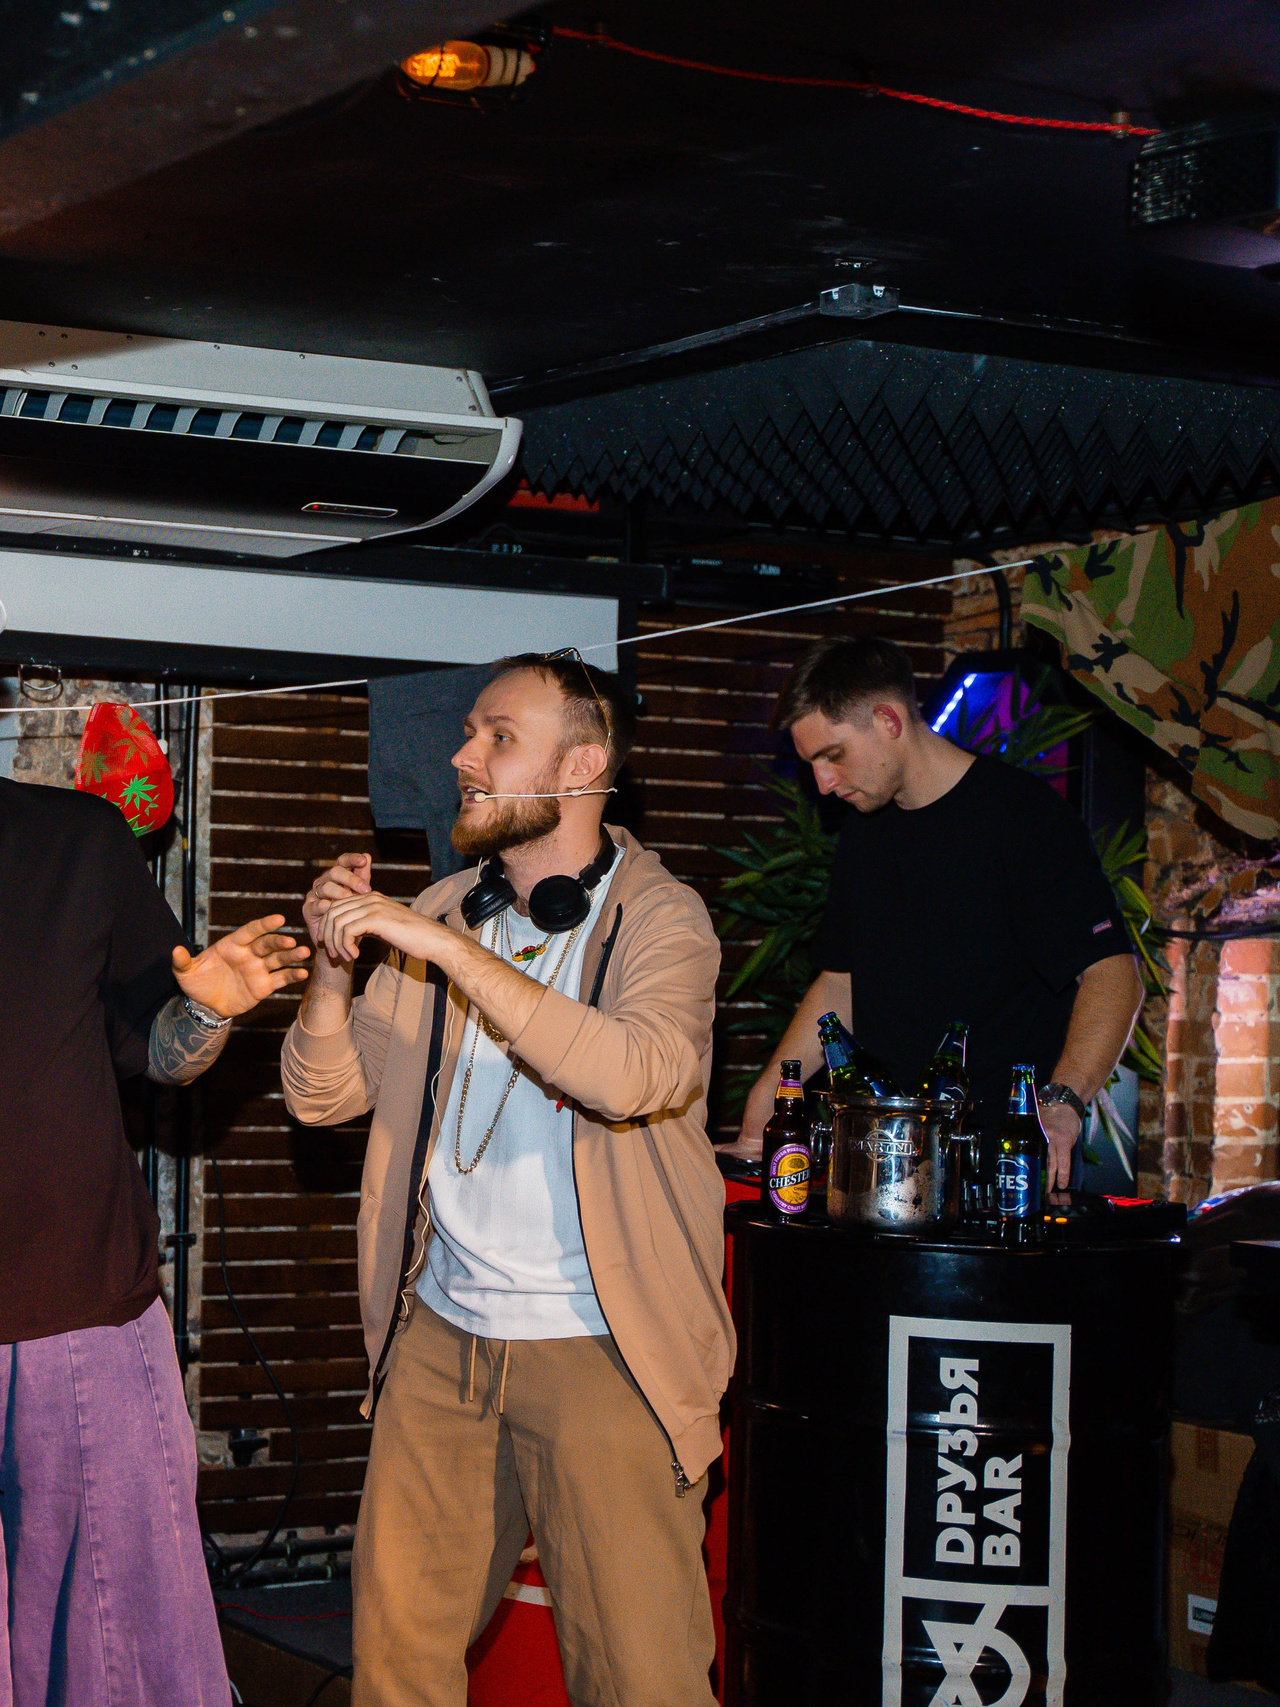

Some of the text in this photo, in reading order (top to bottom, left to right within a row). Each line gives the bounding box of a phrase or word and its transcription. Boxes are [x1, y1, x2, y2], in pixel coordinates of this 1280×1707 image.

[850, 1140, 912, 1156] MARTINI
[935, 1357, 980, 1565] DРУЗЬЯ
[982, 1453, 1023, 1567] BAR
